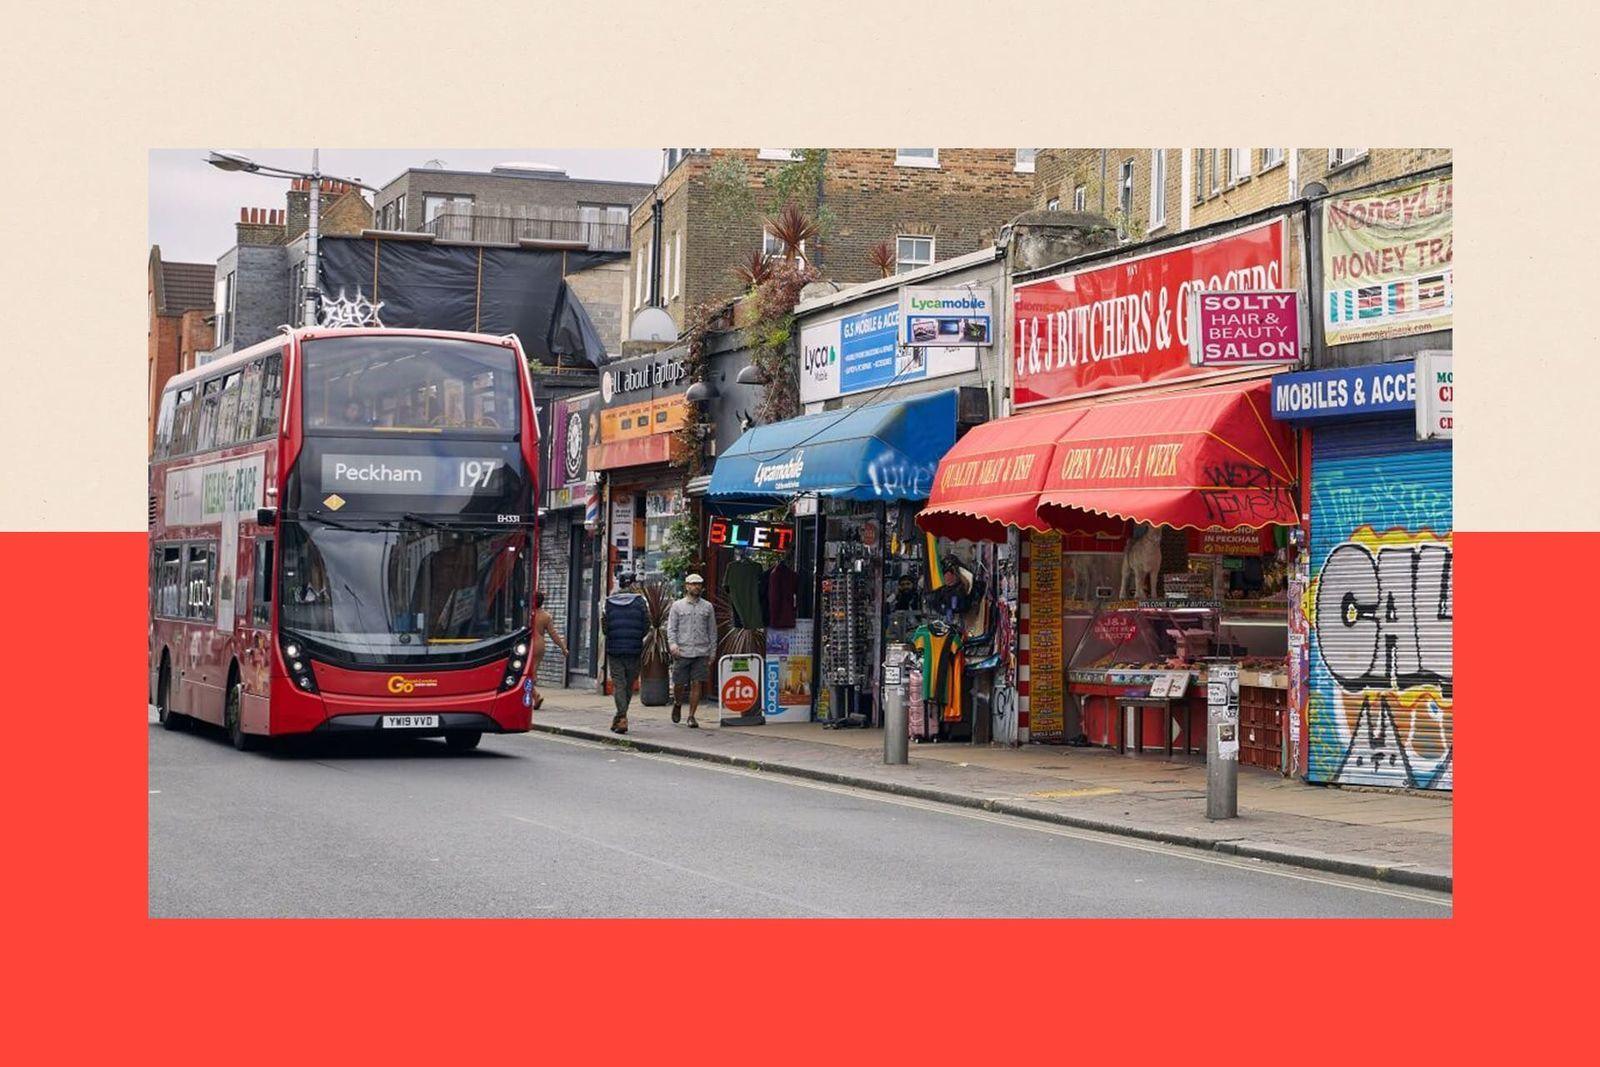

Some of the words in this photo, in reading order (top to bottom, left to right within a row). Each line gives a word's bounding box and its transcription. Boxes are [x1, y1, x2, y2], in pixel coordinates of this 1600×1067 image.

[1332, 245, 1408, 281] MONEY
[911, 297, 986, 311] Lycamobile
[1205, 295, 1291, 311] SOLTY
[1017, 318, 1025, 376] J
[1029, 313, 1041, 374] &
[1045, 310, 1053, 371] J
[1057, 290, 1153, 369] BUTCHERS
[1155, 286, 1172, 351] &
[1209, 325, 1288, 340] BEAUTY
[1211, 313, 1260, 326] HAIR
[1264, 312, 1280, 325] &
[804, 345, 828, 375] Lyca
[1205, 342, 1296, 360] SALON
[624, 364, 650, 391] about
[652, 359, 686, 388] laptops
[1277, 379, 1348, 411] MOBILES
[1354, 378, 1365, 406] &
[1371, 372, 1416, 404] ACCE
[335, 463, 422, 482] Peckham
[459, 460, 496, 488] 197
[753, 450, 804, 487] Lycamobile
[940, 461, 981, 494] QUALITY
[1011, 453, 1036, 481] FISH
[1061, 448, 1096, 480] OPEN
[1092, 447, 1104, 479] 7
[1099, 446, 1135, 479] DAYS
[1131, 446, 1143, 479] A
[1145, 443, 1184, 478] WEEK
[711, 523, 793, 550] BLET
[1216, 535, 1259, 544] PECKHAM
[387, 675, 414, 693] Go
[725, 680, 754, 699] ria
[767, 664, 779, 712] Lebara
[389, 716, 411, 726] YW19
[414, 716, 433, 726] VVD
